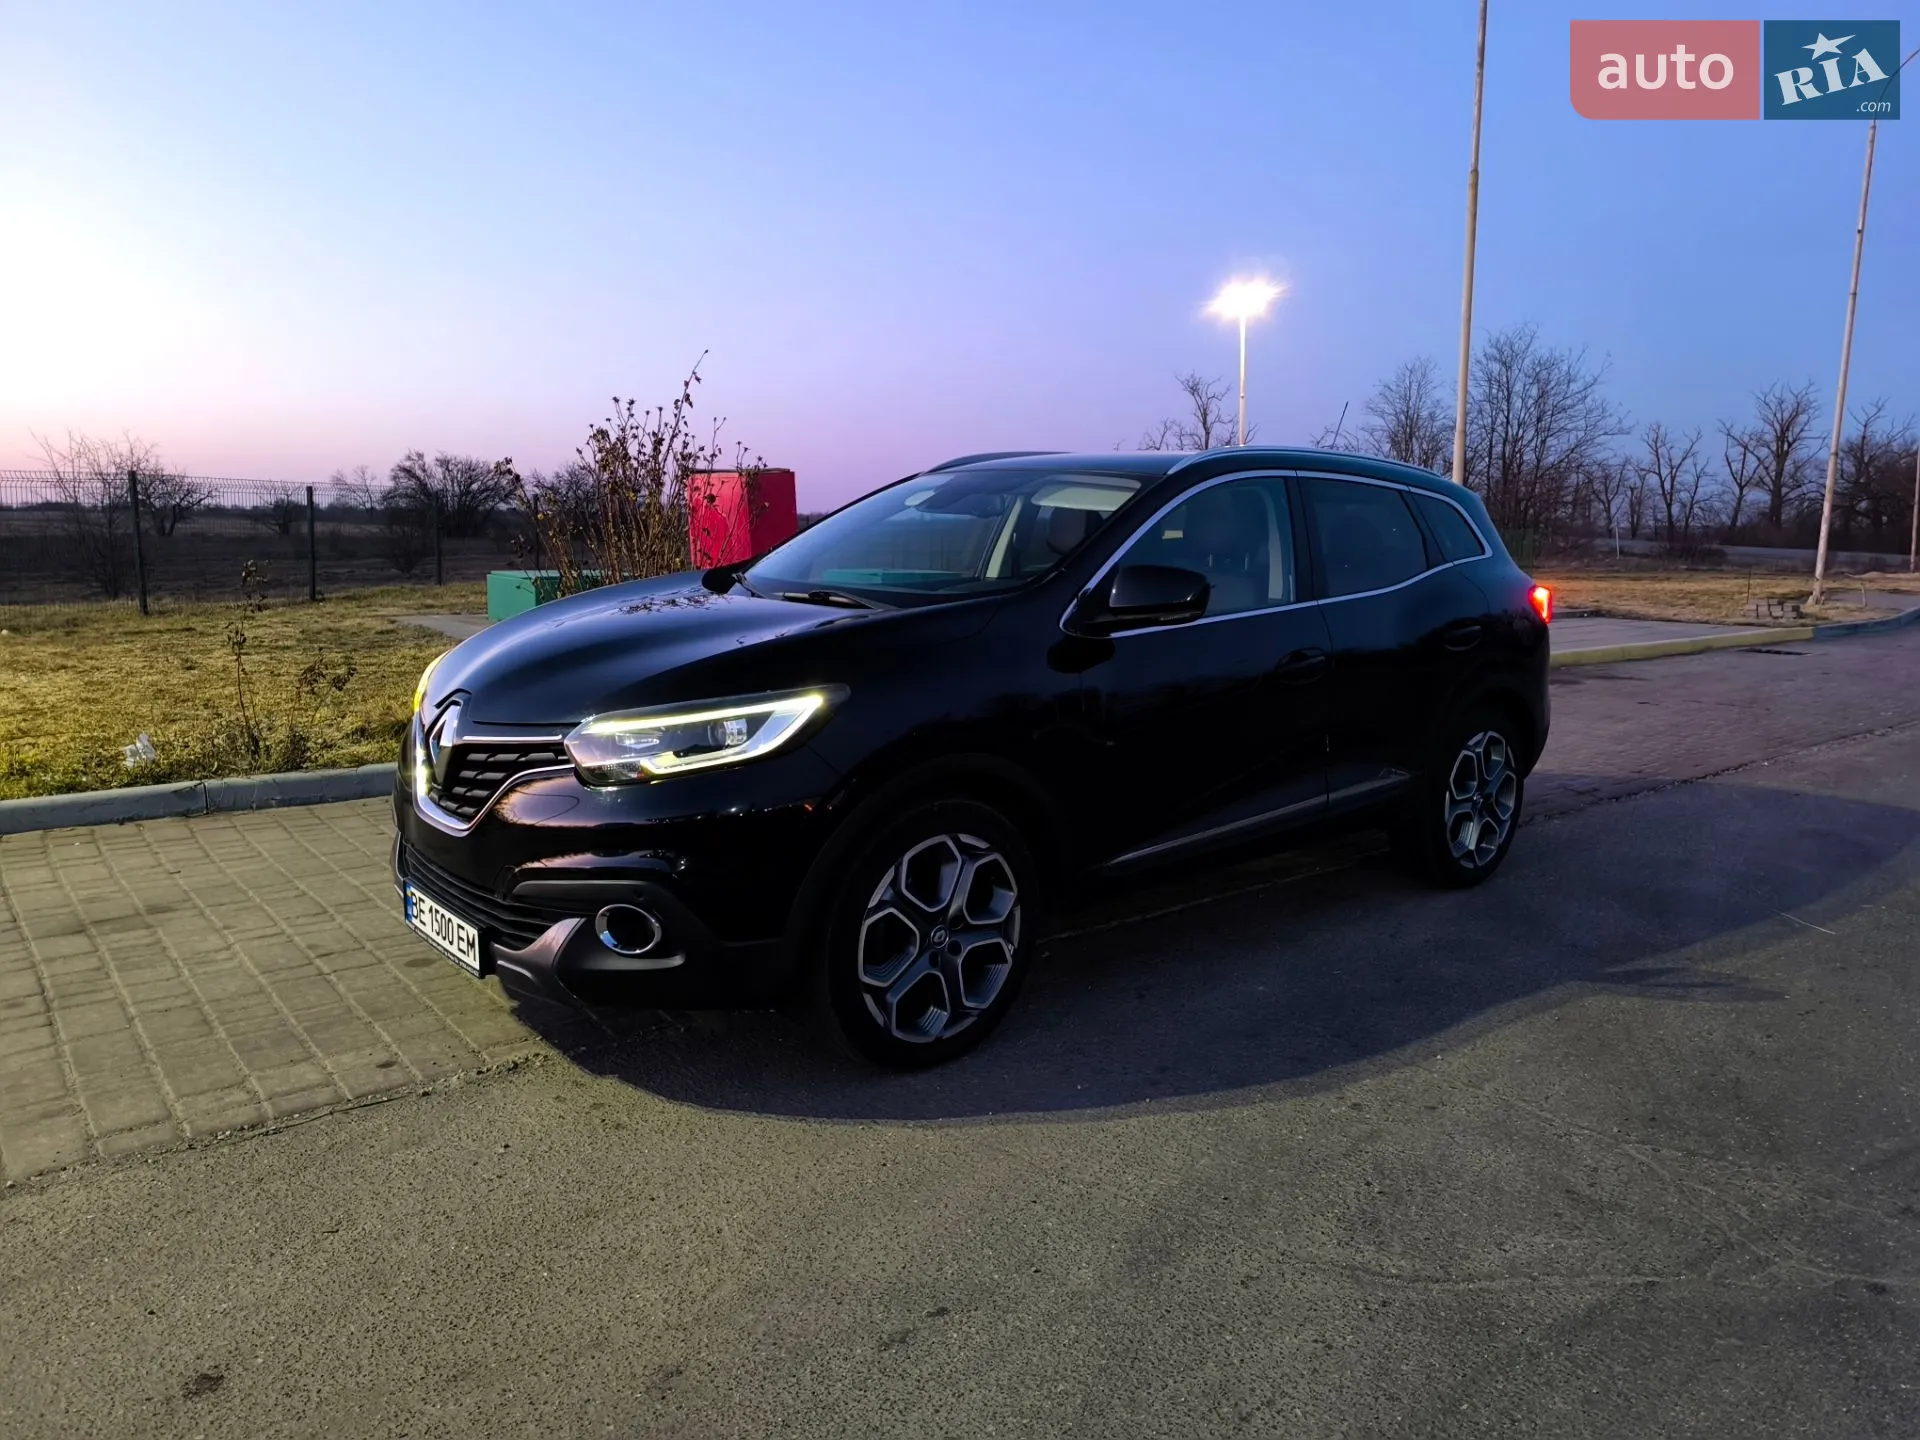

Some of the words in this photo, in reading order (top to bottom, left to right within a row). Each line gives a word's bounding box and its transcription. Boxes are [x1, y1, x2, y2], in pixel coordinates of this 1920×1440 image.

[411, 892, 426, 926] BE
[428, 905, 454, 946] 1500
[457, 923, 476, 962] EM
